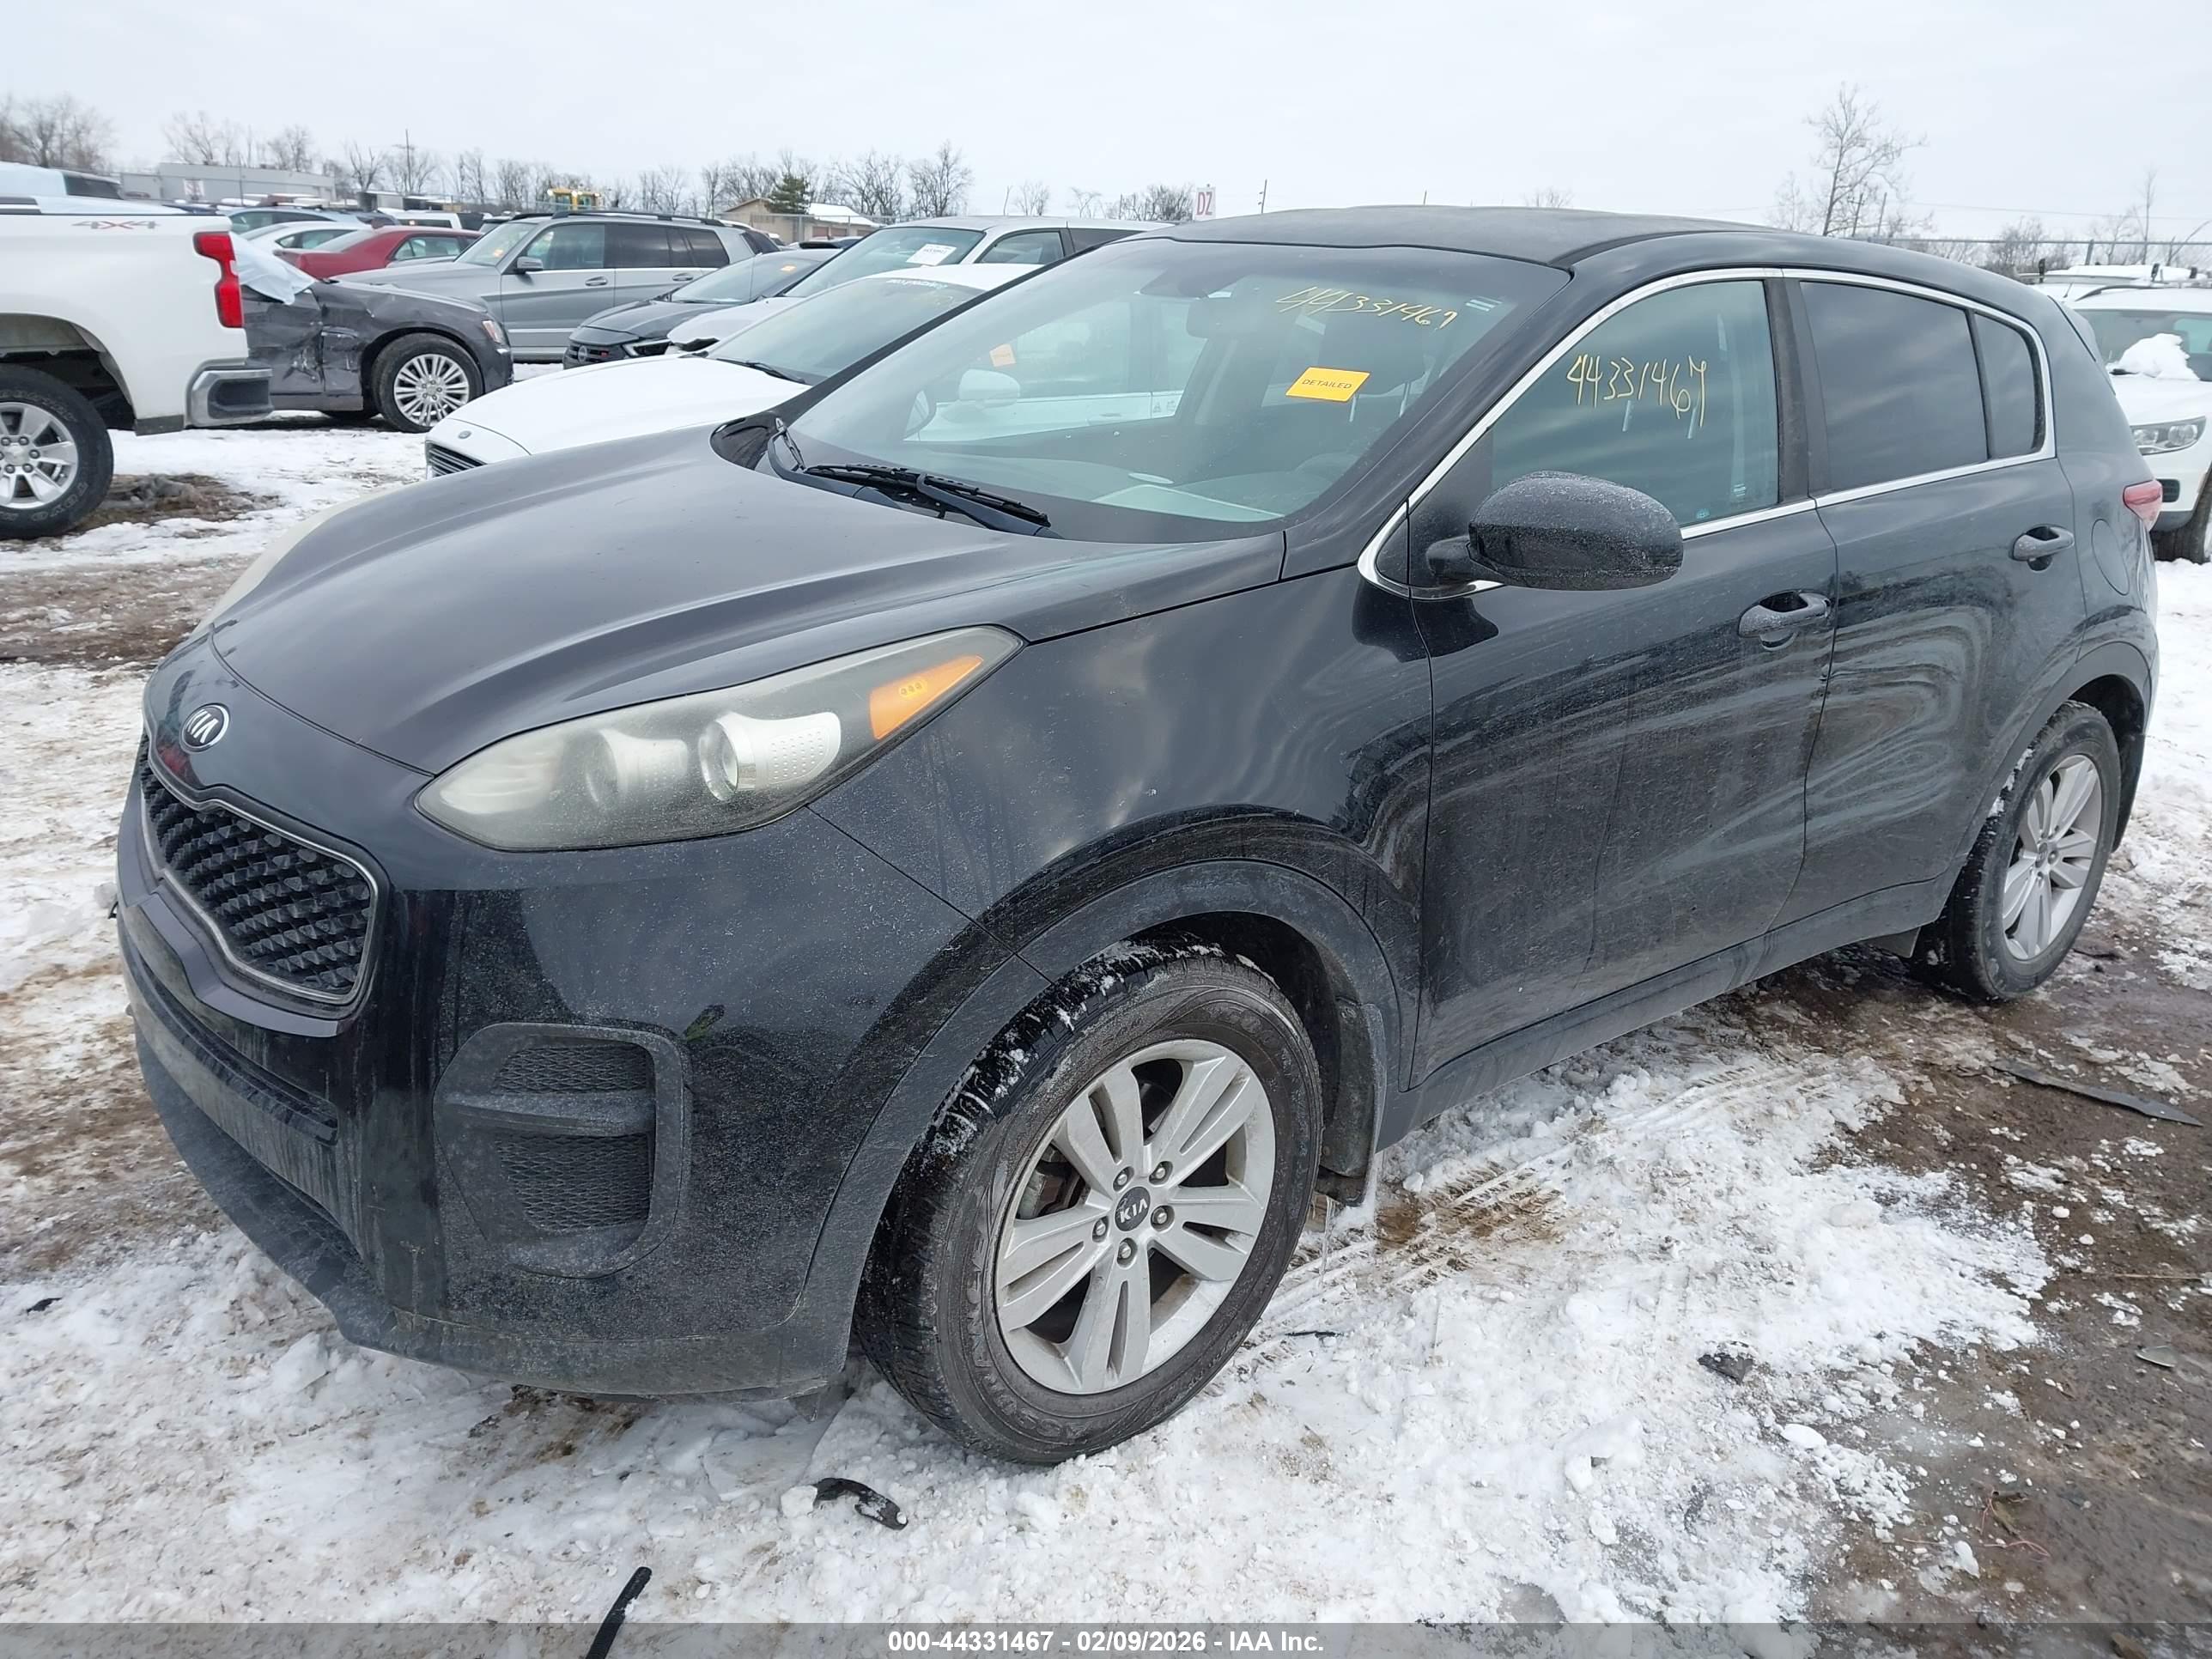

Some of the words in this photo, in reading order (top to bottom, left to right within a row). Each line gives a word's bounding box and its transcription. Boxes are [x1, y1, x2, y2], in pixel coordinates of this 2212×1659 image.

[1196, 191, 1212, 216] DZ
[1274, 286, 1458, 329] 44331467
[1302, 379, 1352, 389] DETAILED
[1566, 354, 1707, 428] 44331467
[1120, 1198, 1148, 1224] KIA
